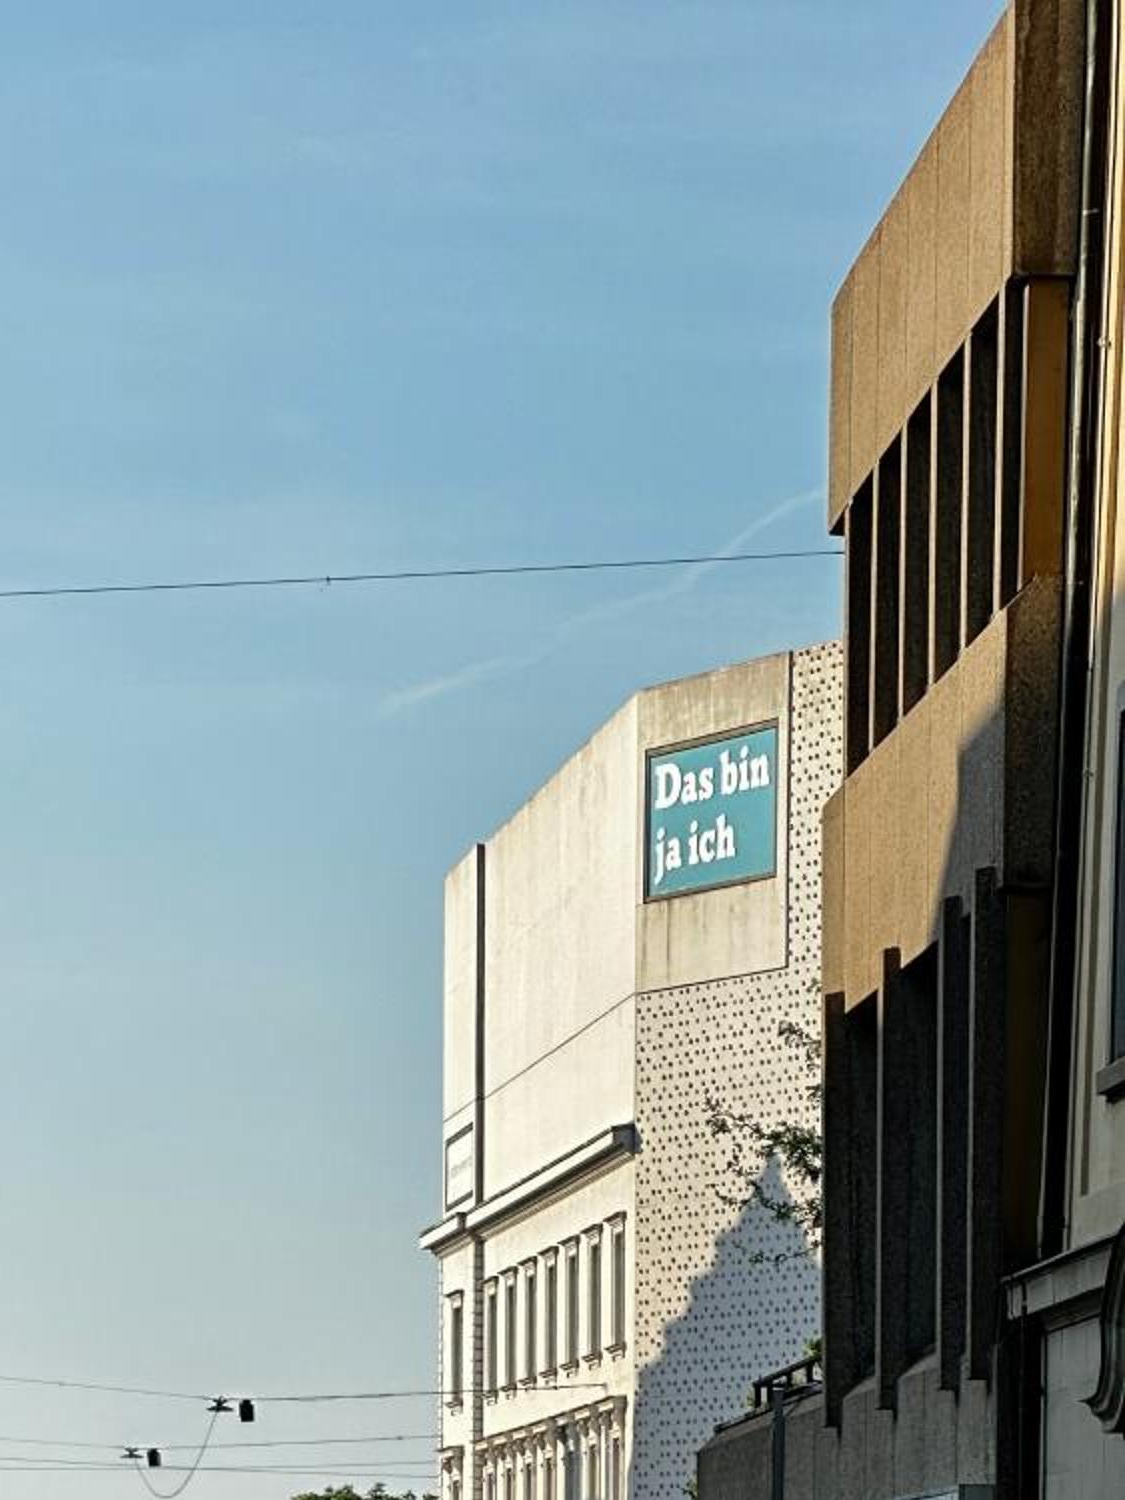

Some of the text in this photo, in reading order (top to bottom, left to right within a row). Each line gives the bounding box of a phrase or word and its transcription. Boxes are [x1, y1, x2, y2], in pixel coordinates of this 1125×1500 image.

[654, 744, 770, 810] Das bin
[654, 812, 736, 886] ja ich
